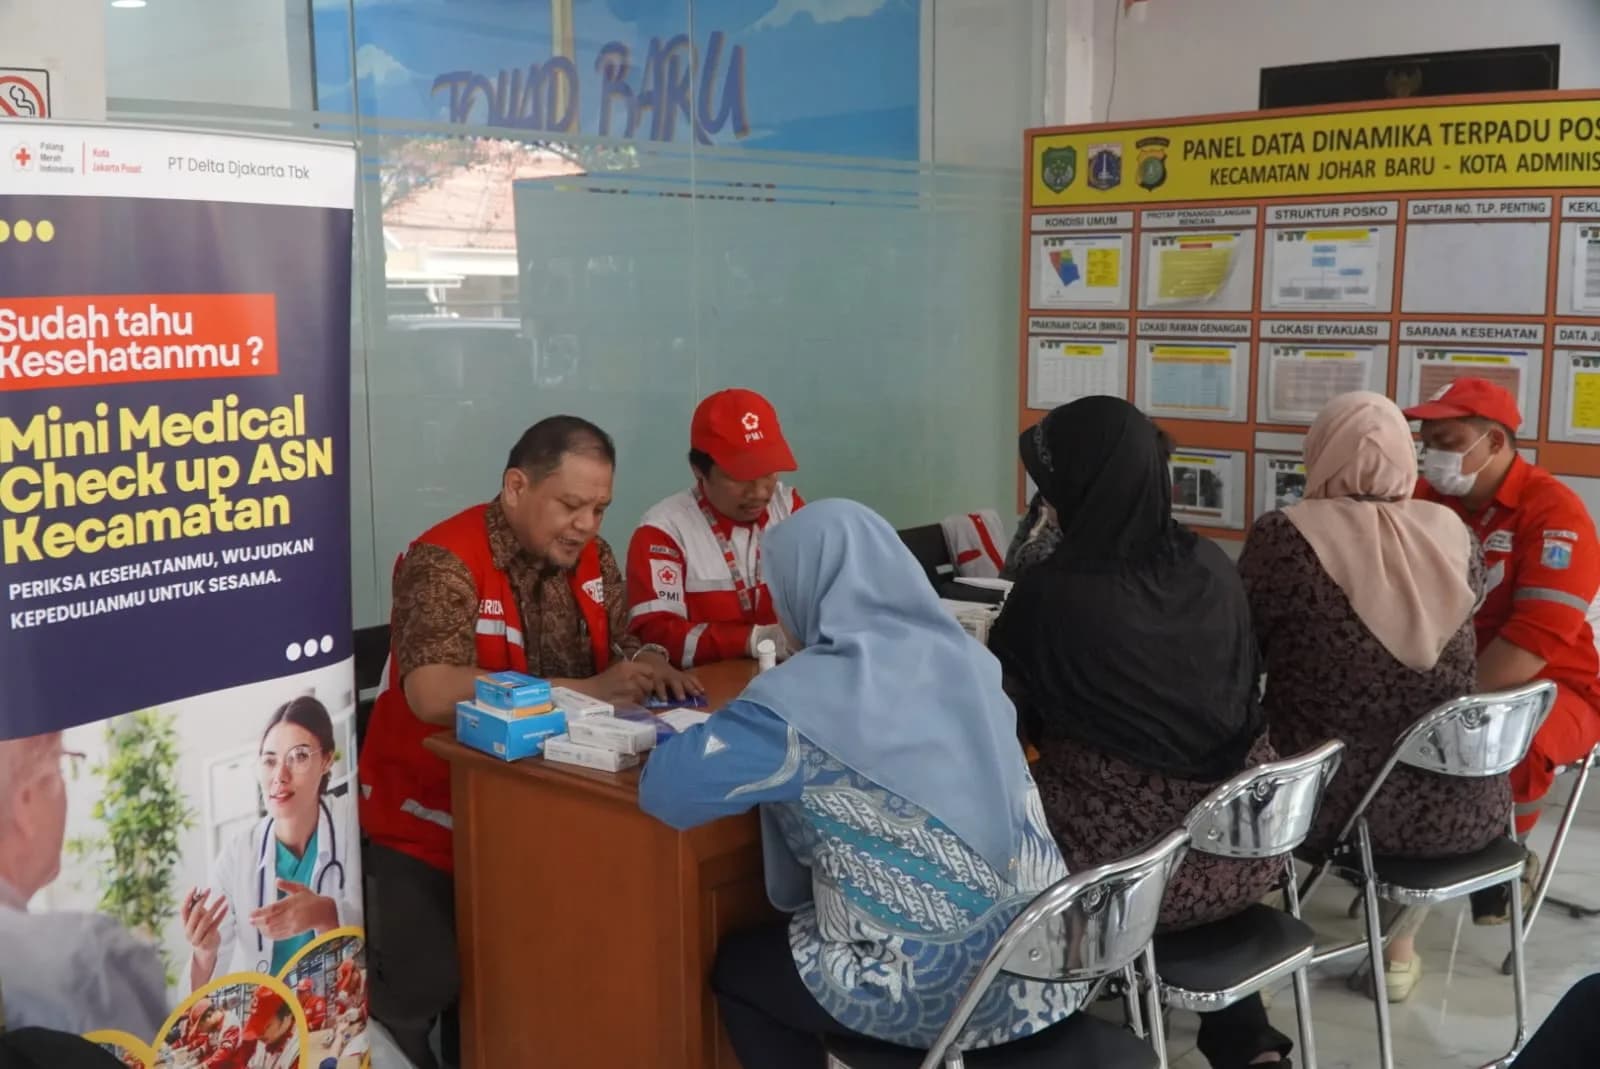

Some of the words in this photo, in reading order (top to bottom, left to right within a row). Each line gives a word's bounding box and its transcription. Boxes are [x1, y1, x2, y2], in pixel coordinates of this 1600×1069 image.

[1183, 136, 1245, 161] PANEL
[1252, 132, 1305, 156] DATA
[1312, 124, 1432, 153] DINAMIKA
[1440, 119, 1550, 146] TERPADU
[168, 157, 184, 171] PT
[188, 158, 225, 175] Delta
[229, 160, 285, 179] Djakarta
[288, 164, 310, 179] Tbk
[1210, 163, 1310, 186] KECAMATAN
[1317, 159, 1376, 181] JOHAR
[1384, 157, 1435, 178] BARU
[1460, 154, 1507, 174] KOTA
[1516, 151, 1600, 173] ADMINIS
[1045, 217, 1085, 228] KONDISI
[1087, 216, 1118, 227] UMUM
[1275, 208, 1340, 220] STRUKTUR
[1343, 206, 1388, 217] POSKO
[1413, 204, 1452, 216] DAFTAR
[1455, 203, 1473, 214] NO.
[1476, 203, 1497, 214] TLP.
[1500, 202, 1546, 213] PENTING
[0, 304, 109, 342] Sudah
[115, 304, 193, 337] tahu
[1140, 322, 1168, 333] LOKASI
[1169, 322, 1199, 333] RAWAN
[1199, 322, 1248, 334] GENANGAN
[1271, 324, 1313, 335] LOKASI
[1317, 325, 1378, 336] EVAKUASI
[1406, 326, 1457, 337] SARANA
[1461, 327, 1538, 340] KESEHATAN
[1560, 329, 1588, 340] DATA
[0, 341, 240, 379] Kesehatanmu
[246, 336, 264, 366] ?
[0, 402, 109, 464] Mini
[119, 393, 306, 451] Medical
[744, 430, 764, 443] PMI
[0, 452, 168, 513] Check
[175, 454, 240, 500] up
[248, 437, 334, 485] ASN
[3, 494, 290, 564] Kecamatan
[9, 574, 87, 600] PERIKSA
[90, 553, 218, 588] KESEHATANMU,
[222, 537, 314, 565] WUJUDKAN
[11, 590, 145, 630] KEPEDULIANMU
[148, 580, 206, 604] UNTUK
[208, 569, 282, 597] SESAMA.
